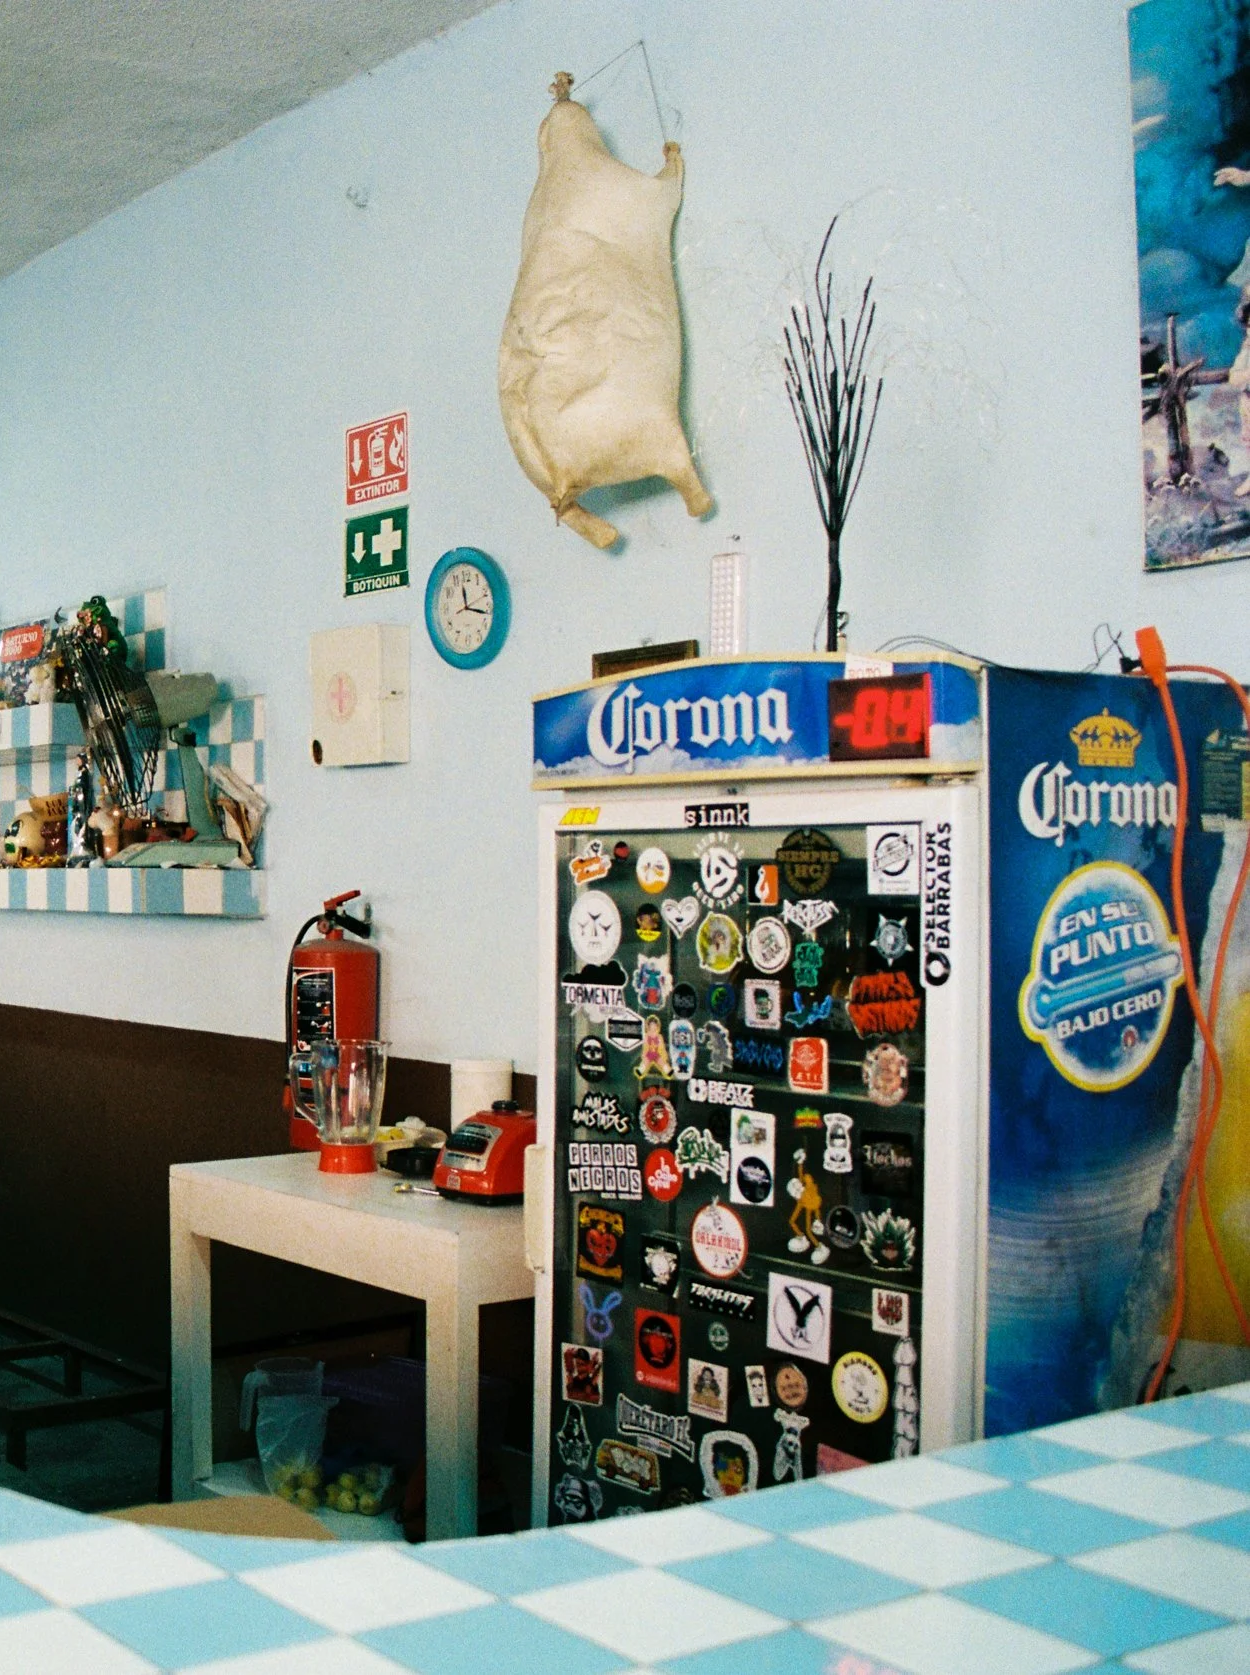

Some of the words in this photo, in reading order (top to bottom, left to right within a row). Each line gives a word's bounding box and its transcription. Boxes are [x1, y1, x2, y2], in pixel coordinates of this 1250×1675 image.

[355, 479, 399, 501] EXTINTOR
[353, 574, 400, 593] BOTIQUIN
[587, 682, 793, 775] Corona
[685, 804, 749, 827] sinnk
[1018, 760, 1178, 848] Corona
[936, 821, 951, 949] BARRABAS
[1058, 906, 1097, 938] EN
[1050, 921, 1156, 976] PUNTO
[564, 985, 626, 1005] TORMENTA
[1056, 1006, 1110, 1040] BAJO
[1112, 988, 1163, 1021] CERO
[570, 1145, 637, 1165] PERROS
[570, 1169, 641, 1191] NEGROS
